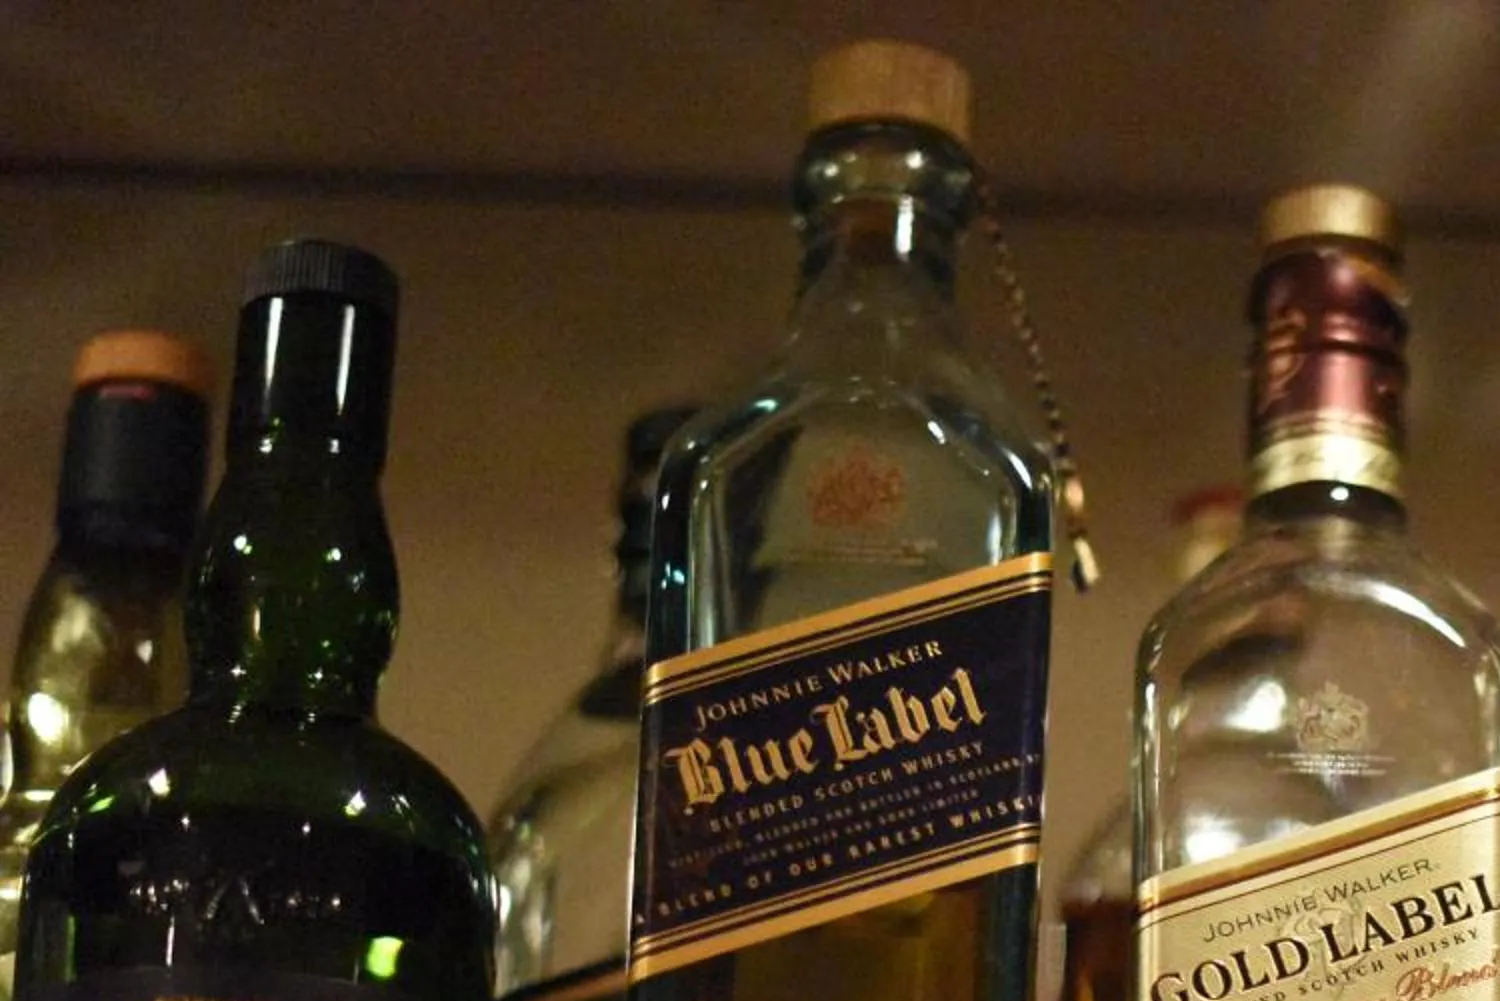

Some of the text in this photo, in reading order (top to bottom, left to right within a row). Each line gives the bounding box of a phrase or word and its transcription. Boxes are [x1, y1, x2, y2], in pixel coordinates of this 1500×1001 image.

[696, 639, 943, 730] JOHNNIE WALKER
[664, 666, 987, 816] Blue Label
[710, 741, 983, 833] BLENDED SCOTCH WHISKY
[658, 884, 732, 917] BLEND
[748, 870, 772, 889] OF
[789, 853, 833, 876] OUR
[849, 821, 935, 859] RAREST
[950, 794, 1040, 829] WHISKI
[1202, 857, 1433, 944] JOHNNIE WALKER
[1298, 958, 1385, 997] SCOTCH
[1394, 928, 1480, 963] WHISKY
